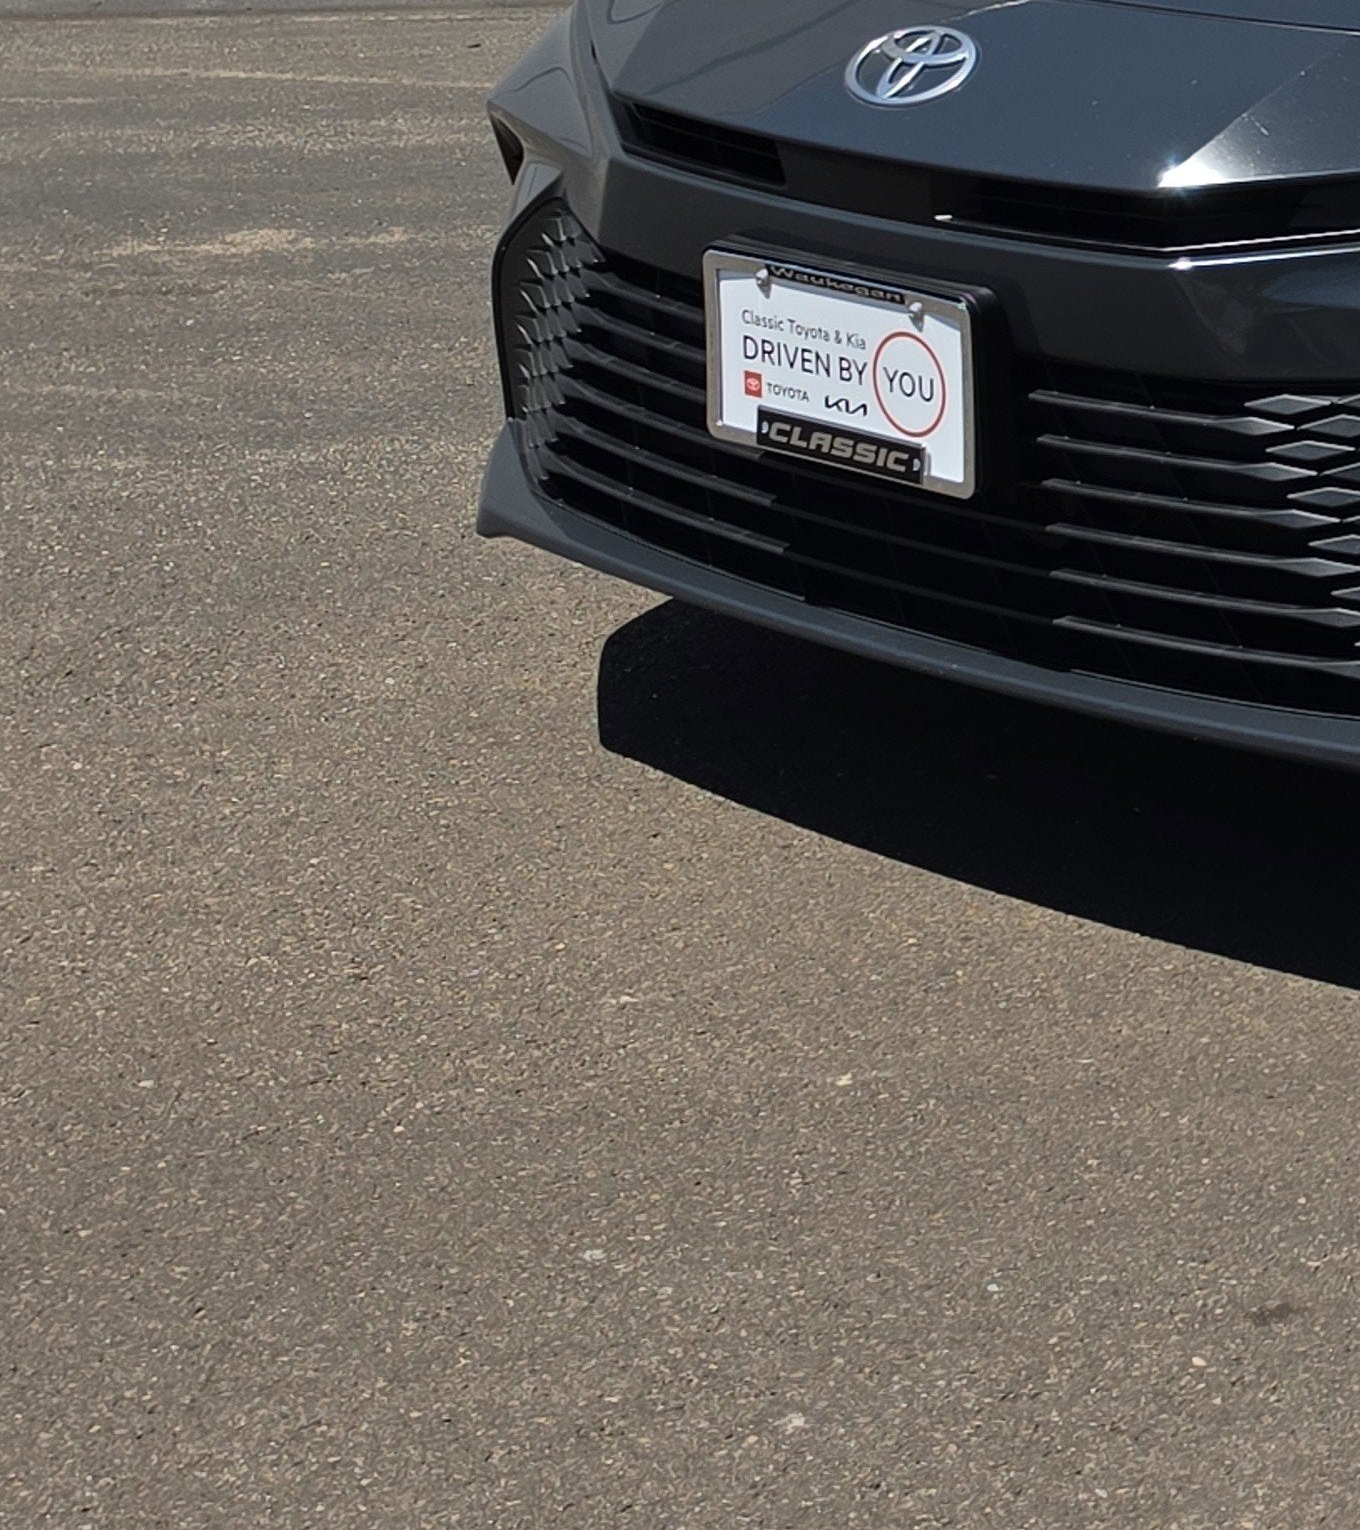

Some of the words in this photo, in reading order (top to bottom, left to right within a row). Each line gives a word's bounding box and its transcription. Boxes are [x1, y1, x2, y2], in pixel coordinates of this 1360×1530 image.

[770, 265, 902, 302] Waukegan
[742, 309, 784, 331] Classic
[787, 319, 830, 343] Toyota
[834, 329, 843, 344] &
[846, 333, 867, 350] Kia
[743, 335, 831, 377] DRIVEN
[839, 356, 868, 385] BY
[883, 366, 935, 403] YOU
[766, 382, 810, 402] TOYOTA
[769, 422, 910, 472] CLASSIC
